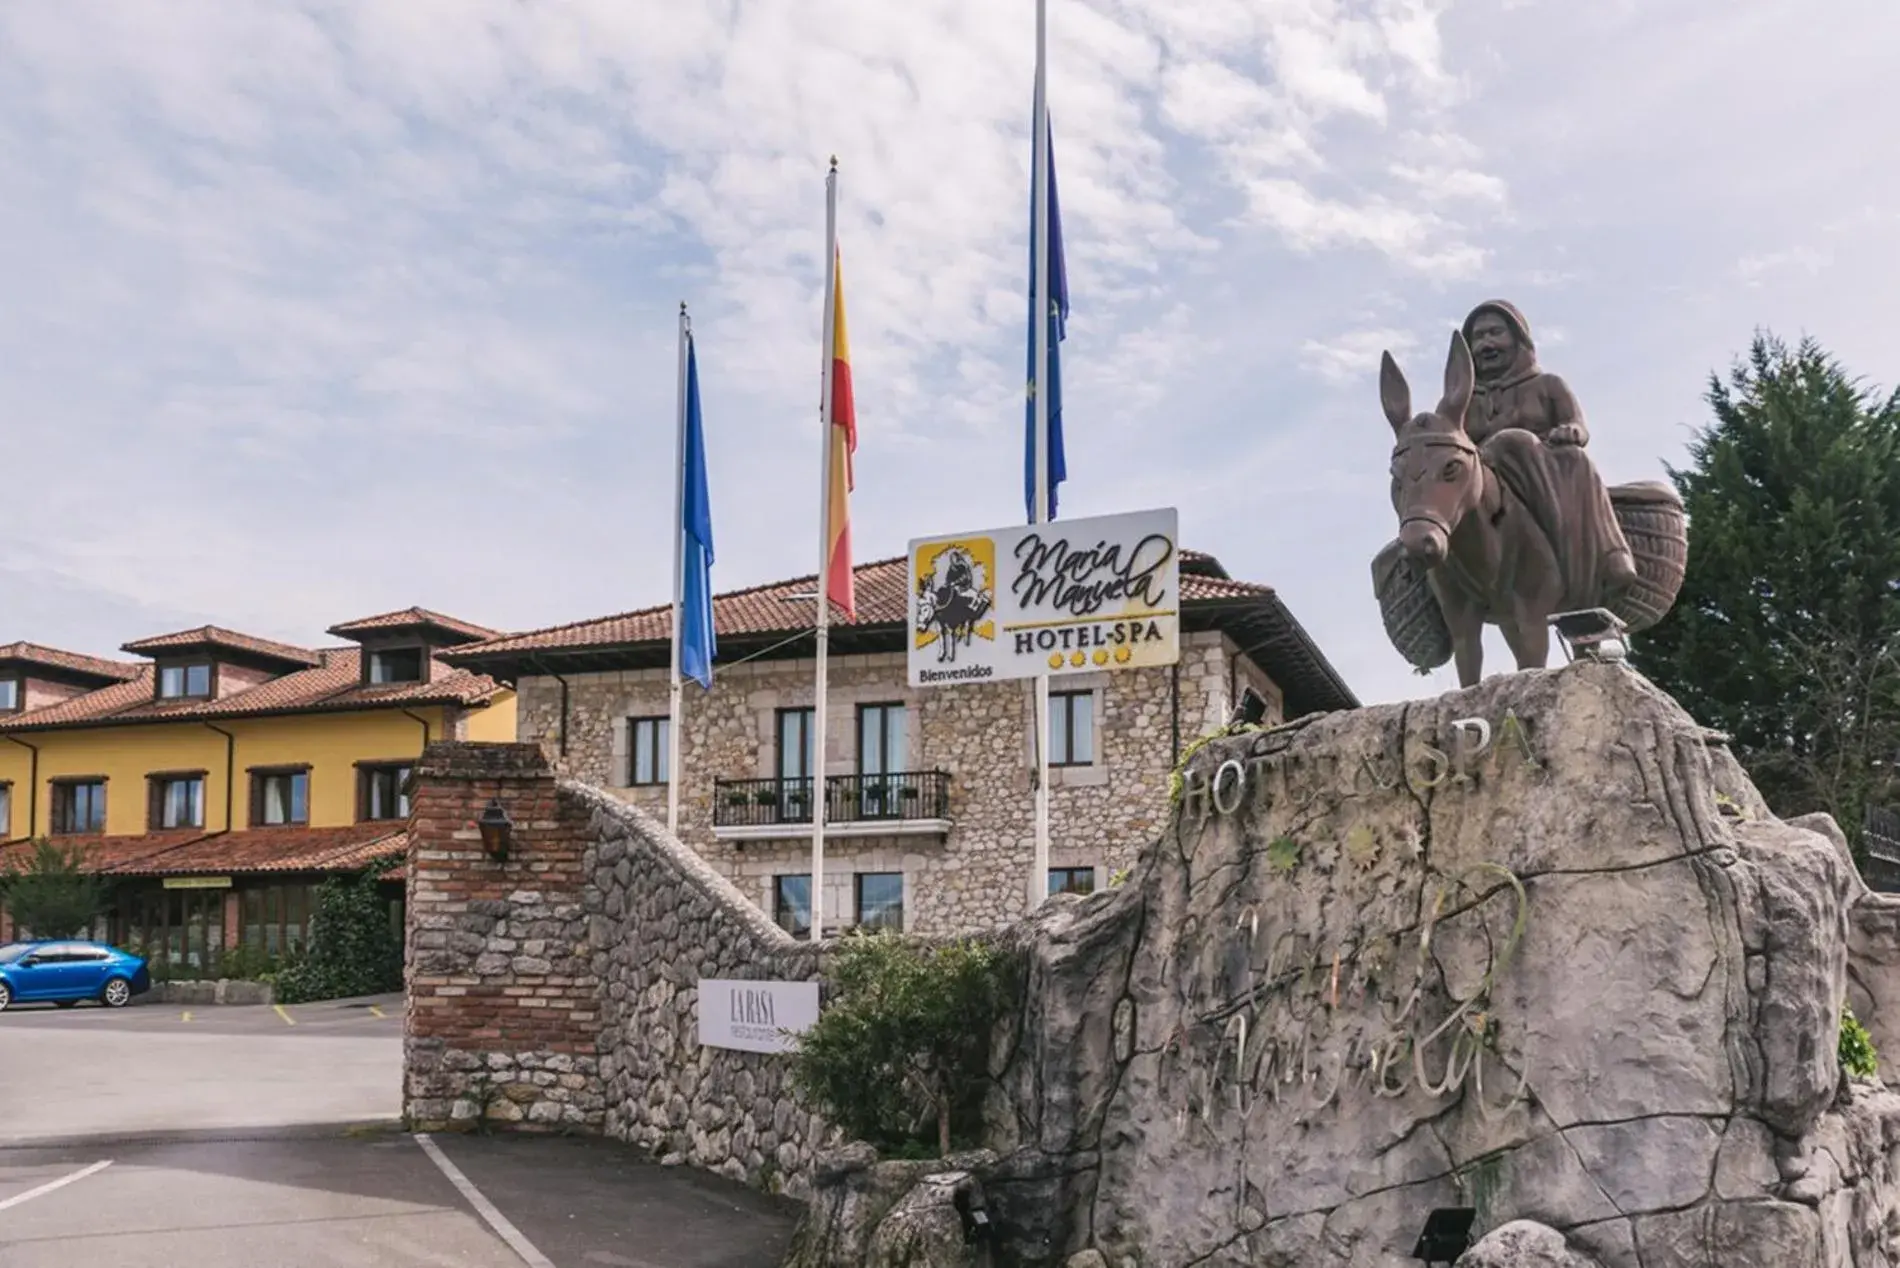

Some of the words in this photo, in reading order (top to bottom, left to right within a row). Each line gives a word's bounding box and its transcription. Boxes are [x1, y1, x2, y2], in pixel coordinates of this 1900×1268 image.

[1012, 534, 1173, 615] Manuela
[1014, 621, 1163, 654] HOTEL-SPA
[919, 665, 993, 682] Bienvenidos
